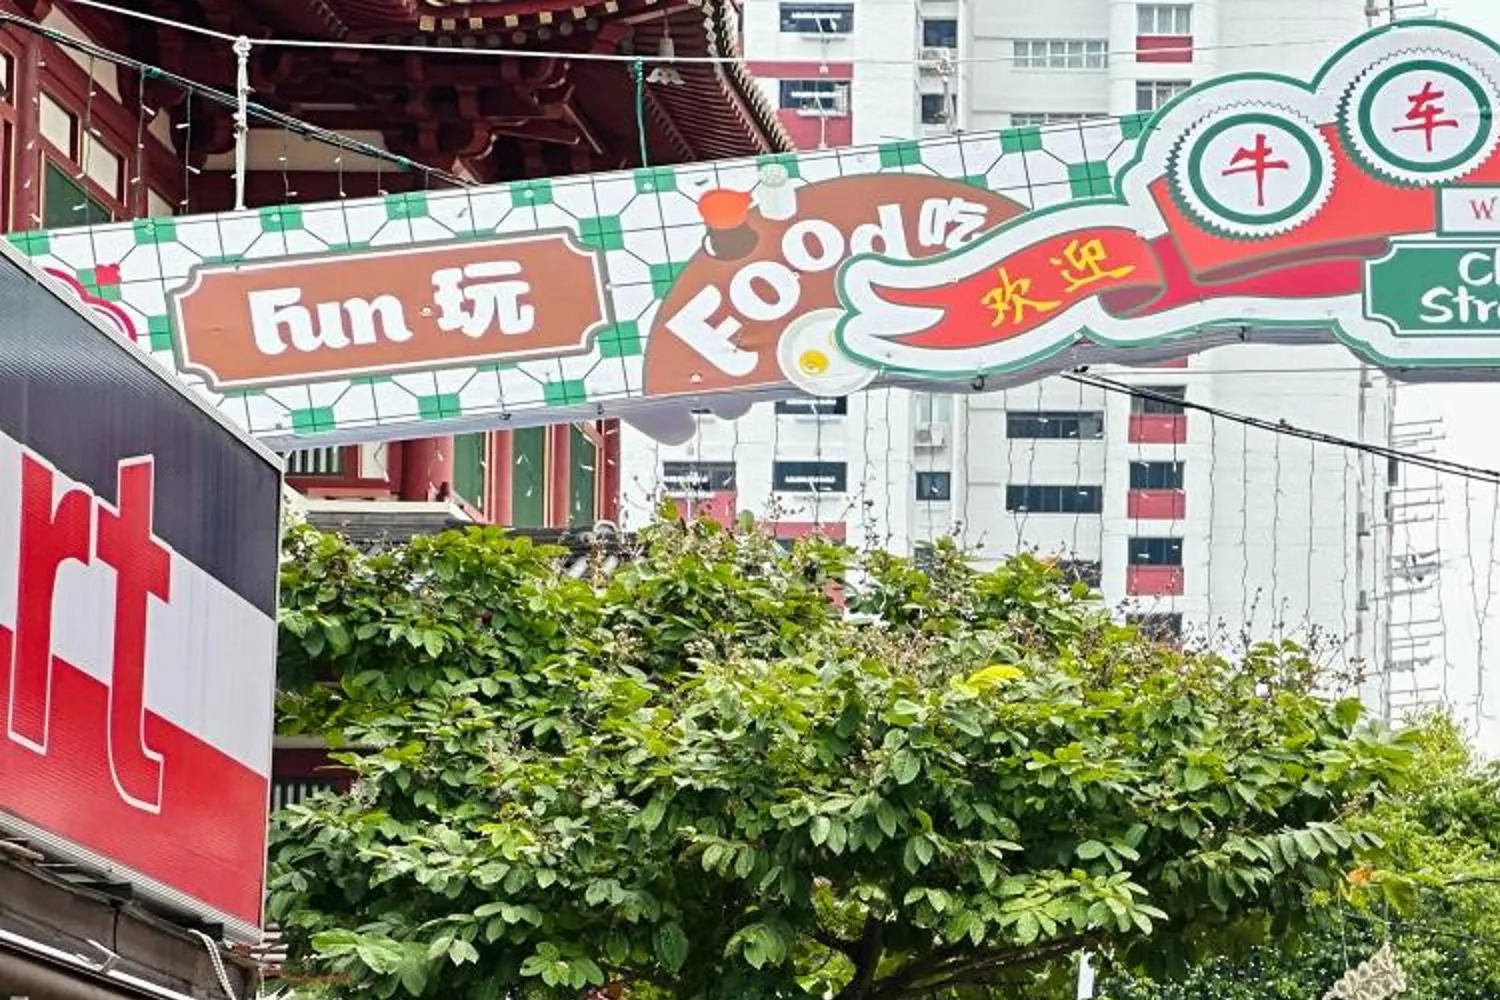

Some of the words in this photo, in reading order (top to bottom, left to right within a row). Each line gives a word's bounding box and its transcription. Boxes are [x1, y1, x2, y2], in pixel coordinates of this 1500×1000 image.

[248, 286, 413, 356] Fun
[433, 259, 536, 340] 玩
[665, 203, 914, 378] Food
[917, 197, 989, 252] 吃
[982, 237, 1137, 327] 欢迎
